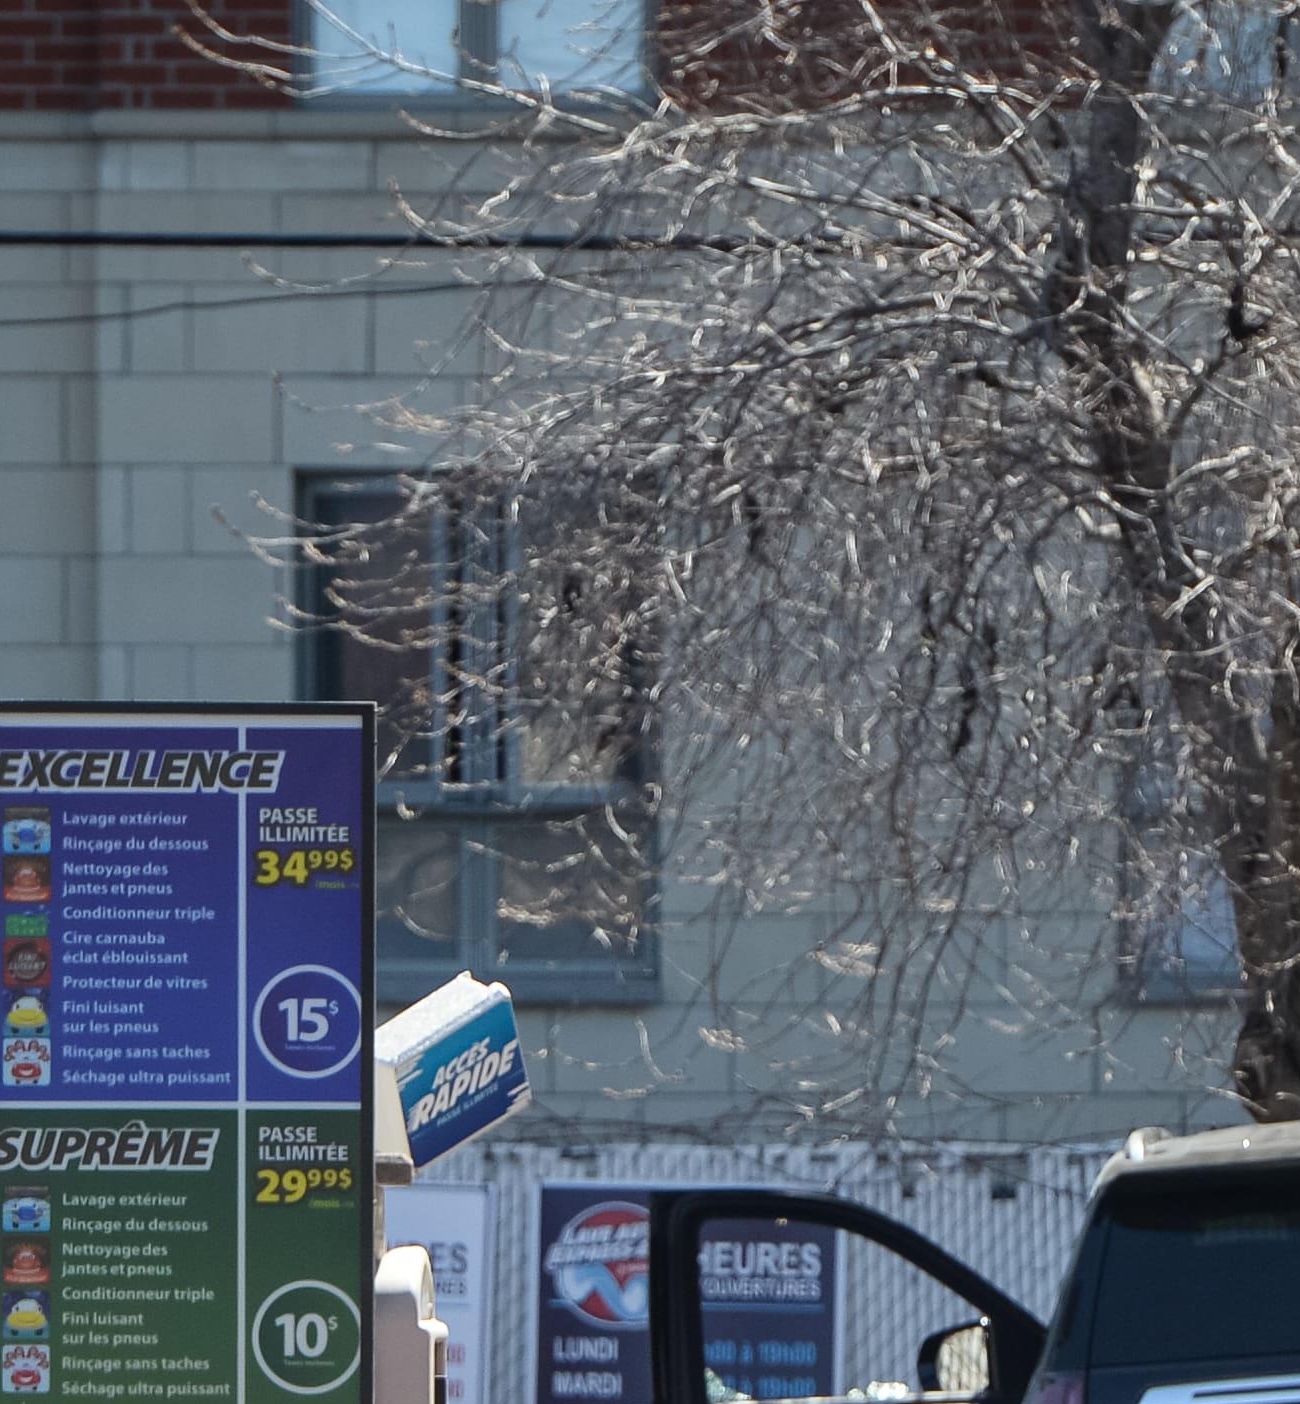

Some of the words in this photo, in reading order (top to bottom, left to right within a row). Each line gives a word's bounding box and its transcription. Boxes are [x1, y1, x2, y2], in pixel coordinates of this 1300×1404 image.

[63, 812, 115, 828] Lavage
[120, 812, 187, 825] extérieur
[259, 808, 318, 824] PASSE
[259, 822, 350, 842] ILLIMITÉE
[63, 837, 122, 852] Rinçage
[126, 837, 144, 850] du
[149, 837, 208, 850] dessous
[63, 862, 140, 878] Nettoyage
[143, 862, 168, 875] des
[62, 882, 108, 897] jantes
[111, 883, 125, 894] et
[128, 885, 172, 897] pneus
[63, 906, 170, 919] Conditionneur
[175, 907, 214, 921] triple
[63, 931, 92, 944] Cire
[96, 932, 165, 944] carnauba
[63, 950, 98, 963] éclat
[102, 951, 187, 963] éblouissant
[63, 976, 141, 988] Protecteur
[144, 976, 162, 988] de
[167, 976, 207, 988] vitres
[63, 1001, 89, 1013] Fini
[94, 1001, 143, 1014] luisant
[63, 1023, 86, 1032] sur
[90, 1020, 110, 1033] les
[114, 1023, 158, 1035] pneus
[278, 997, 340, 1042] 15$
[63, 1045, 121, 1061] Rinçage
[126, 1048, 158, 1058] sans
[162, 1045, 210, 1058] taches
[63, 1069, 125, 1086] Séchage
[129, 1070, 163, 1083] ultra
[168, 1071, 230, 1086] puissant
[406, 1036, 519, 1133] RAPIDE
[259, 1126, 317, 1143] PASSE
[259, 1141, 349, 1161] ILLIMITÉE
[63, 1193, 115, 1209] Lavage
[119, 1194, 187, 1206] extérieur
[63, 1218, 121, 1233] Rinçage
[125, 1218, 144, 1230] du
[148, 1218, 208, 1231] dessous
[63, 1243, 140, 1259] Nettoyage
[142, 1243, 167, 1256] des
[62, 1262, 107, 1277] jantes
[110, 1264, 124, 1275] et
[127, 1265, 171, 1277] pneus
[62, 1287, 170, 1300] Conditionneur
[174, 1288, 214, 1303] triple
[63, 1312, 89, 1324] Fini
[93, 1312, 143, 1325] luisant
[63, 1334, 85, 1344] sur
[89, 1331, 109, 1344] les
[113, 1335, 158, 1347] pneus
[274, 1312, 339, 1358] 10$
[553, 1337, 619, 1361] LUNDI
[62, 1356, 121, 1373] Rinçage
[125, 1360, 157, 1369] sans
[162, 1357, 209, 1370] taches
[62, 1381, 124, 1398] Séchage
[128, 1382, 163, 1394] ultra
[167, 1382, 230, 1398] puissant
[553, 1372, 623, 1396] MARDI
